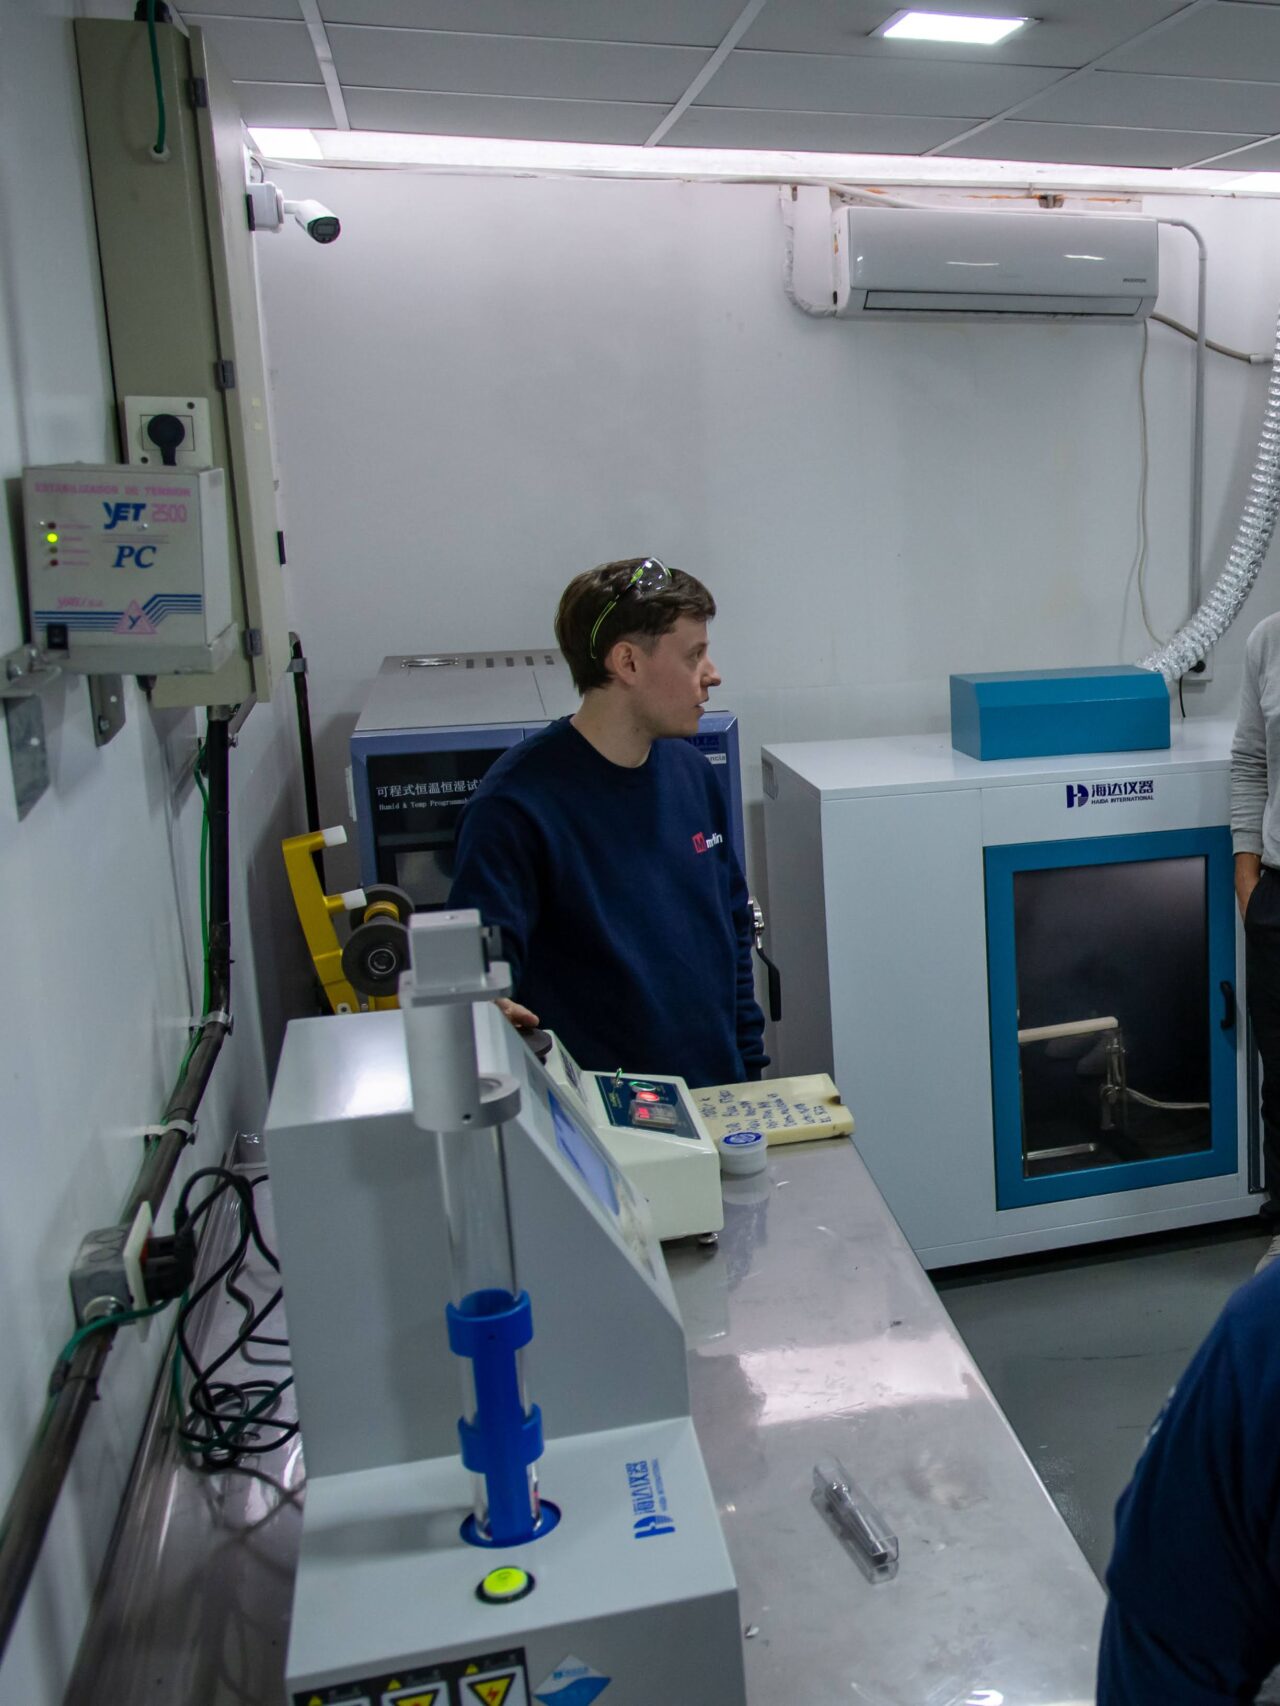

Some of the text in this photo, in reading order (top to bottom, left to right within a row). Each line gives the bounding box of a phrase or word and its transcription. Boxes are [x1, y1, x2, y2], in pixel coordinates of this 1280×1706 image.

[151, 503, 187, 523] 2500
[112, 545, 157, 568] PC
[376, 779, 482, 798] 可程式恒温恒湿试
[1091, 780, 1154, 797] 海达仪器
